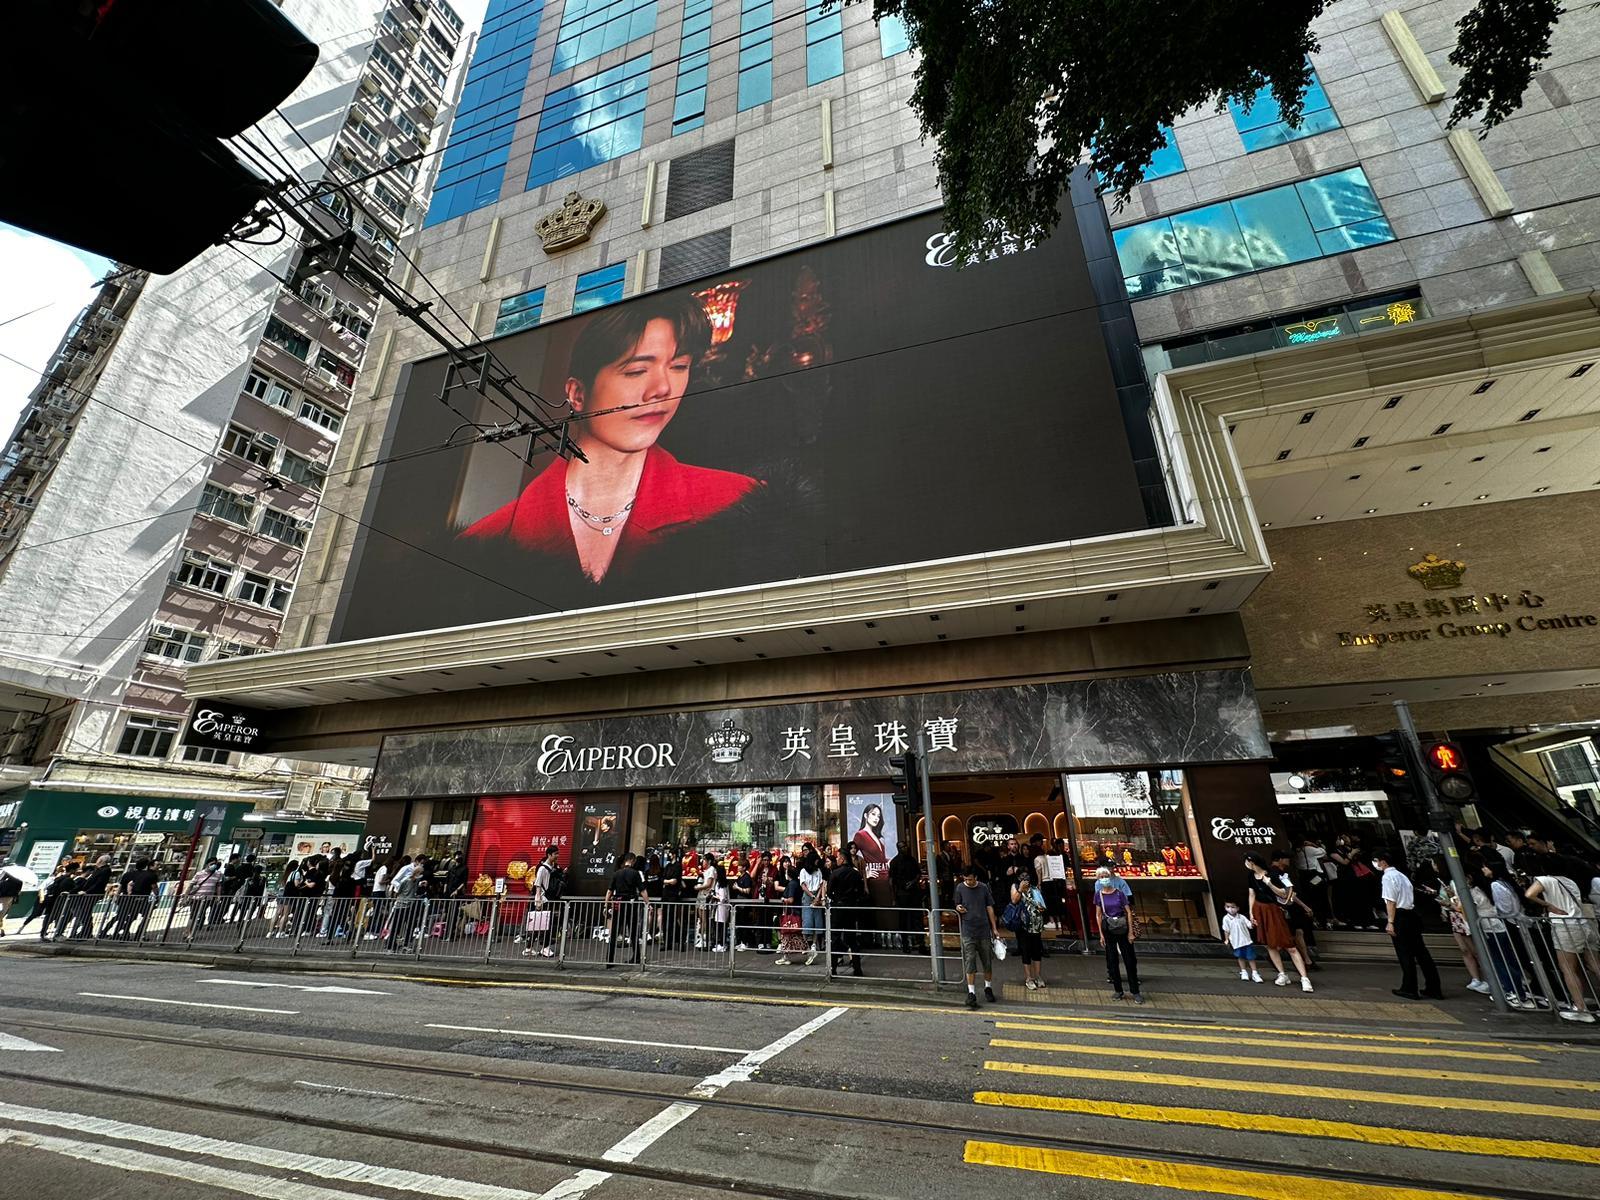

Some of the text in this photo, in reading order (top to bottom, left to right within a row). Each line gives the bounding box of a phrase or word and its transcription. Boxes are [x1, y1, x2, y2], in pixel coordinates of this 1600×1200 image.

[1336, 613, 1597, 649] Emperor Group Centre
[193, 709, 259, 736] EMPEROR
[780, 716, 960, 762] 英皇珠寶
[537, 734, 677, 776] EMPEROR
[1211, 817, 1276, 842] EMPEROR
